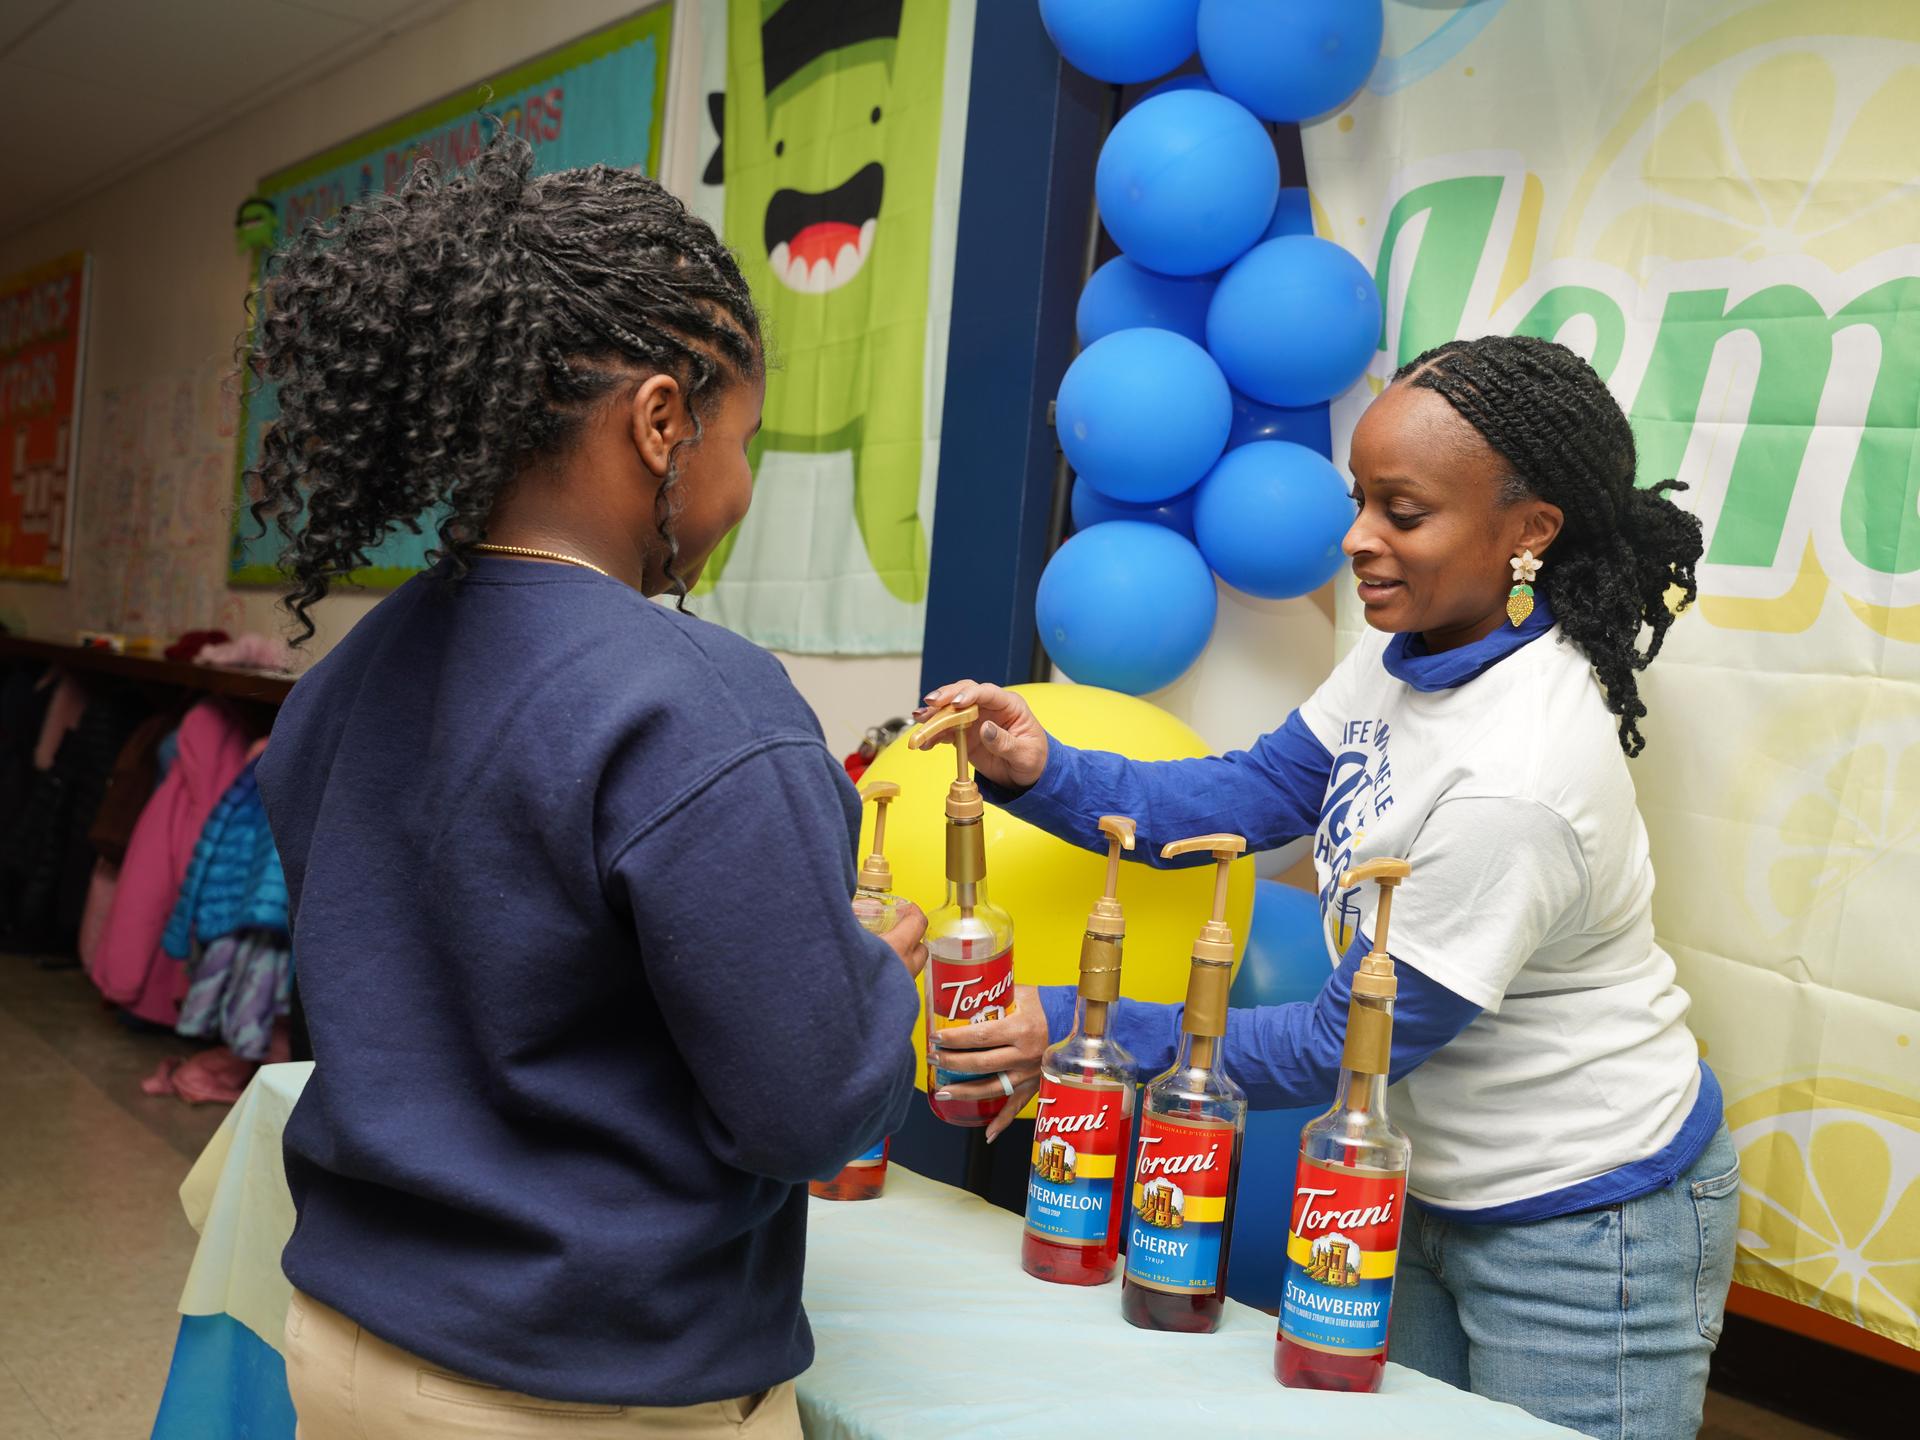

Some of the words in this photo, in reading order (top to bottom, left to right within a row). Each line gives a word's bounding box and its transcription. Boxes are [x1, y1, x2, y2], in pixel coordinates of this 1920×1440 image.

[1340, 720, 1373, 747] IFE
[1034, 1097, 1109, 1141] Torani
[1134, 1136, 1218, 1182] Torani
[1029, 1181, 1103, 1211] ATERMELON
[1295, 1187, 1395, 1238] Torani
[1133, 1228, 1189, 1257] CHERRY
[1144, 1255, 1165, 1265] SYRUP
[1153, 1274, 1170, 1283] 1925
[1286, 1280, 1381, 1317] STRAWBERRY
[1326, 1335, 1345, 1344] 1925
